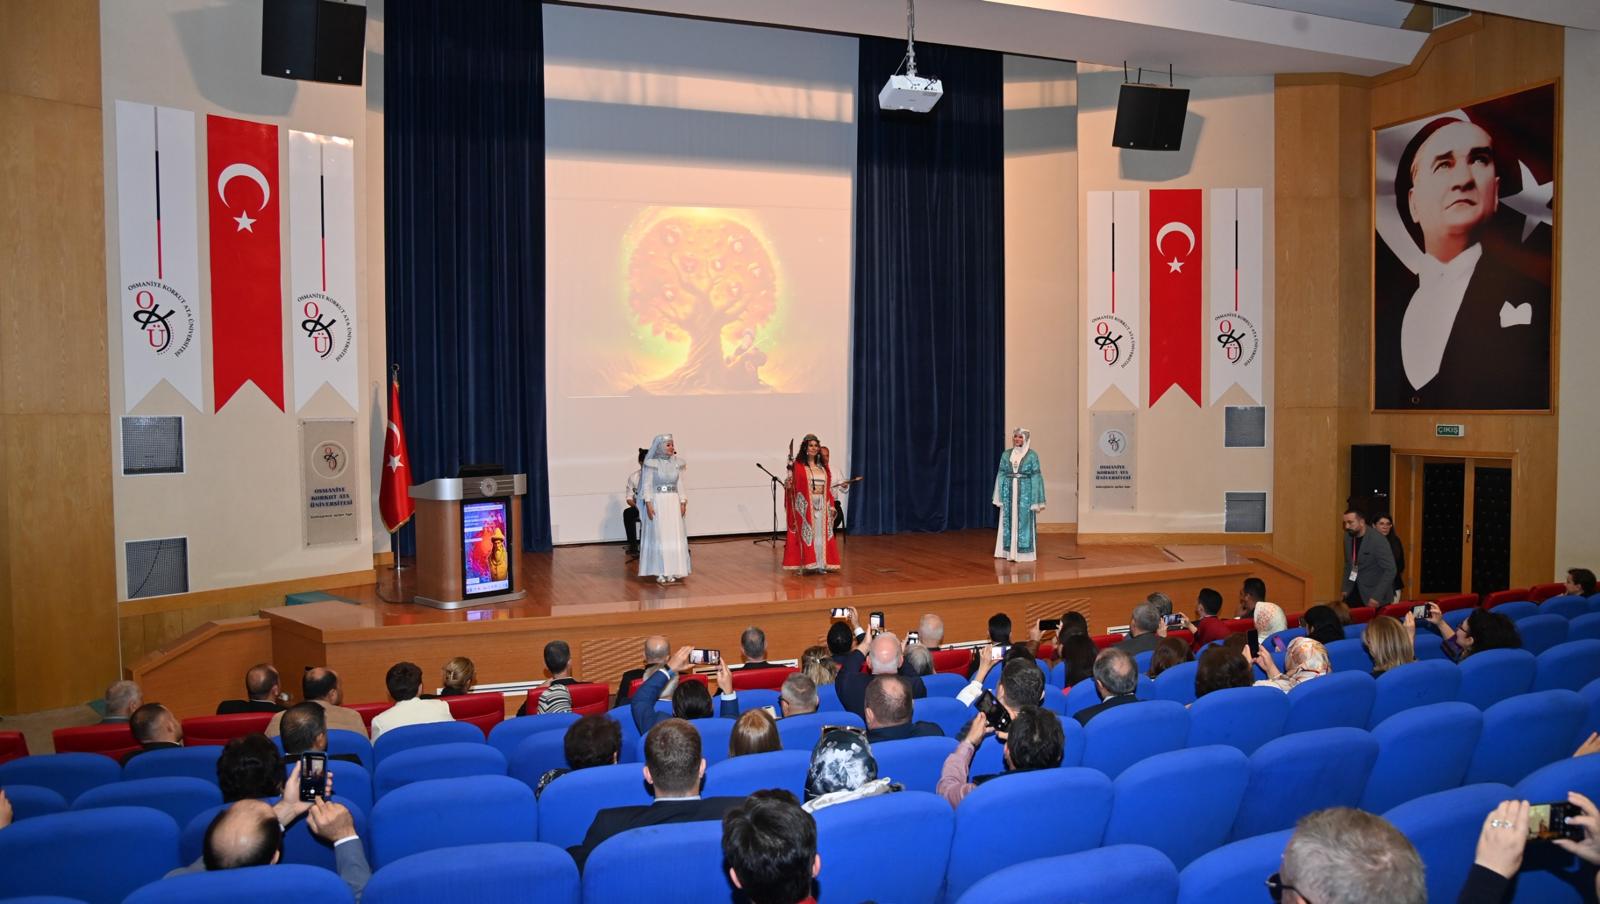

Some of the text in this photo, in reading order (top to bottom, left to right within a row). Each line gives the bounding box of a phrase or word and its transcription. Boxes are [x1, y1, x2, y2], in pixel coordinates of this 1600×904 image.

[127, 281, 161, 291] OSMANİYE
[162, 284, 186, 304] KORKUT
[184, 305, 192, 317] ATA
[297, 292, 325, 303] OSMANİYE
[326, 296, 345, 313] KORKUT
[343, 314, 351, 327] ATA
[1438, 426, 1459, 435] ÇIKIŞ
